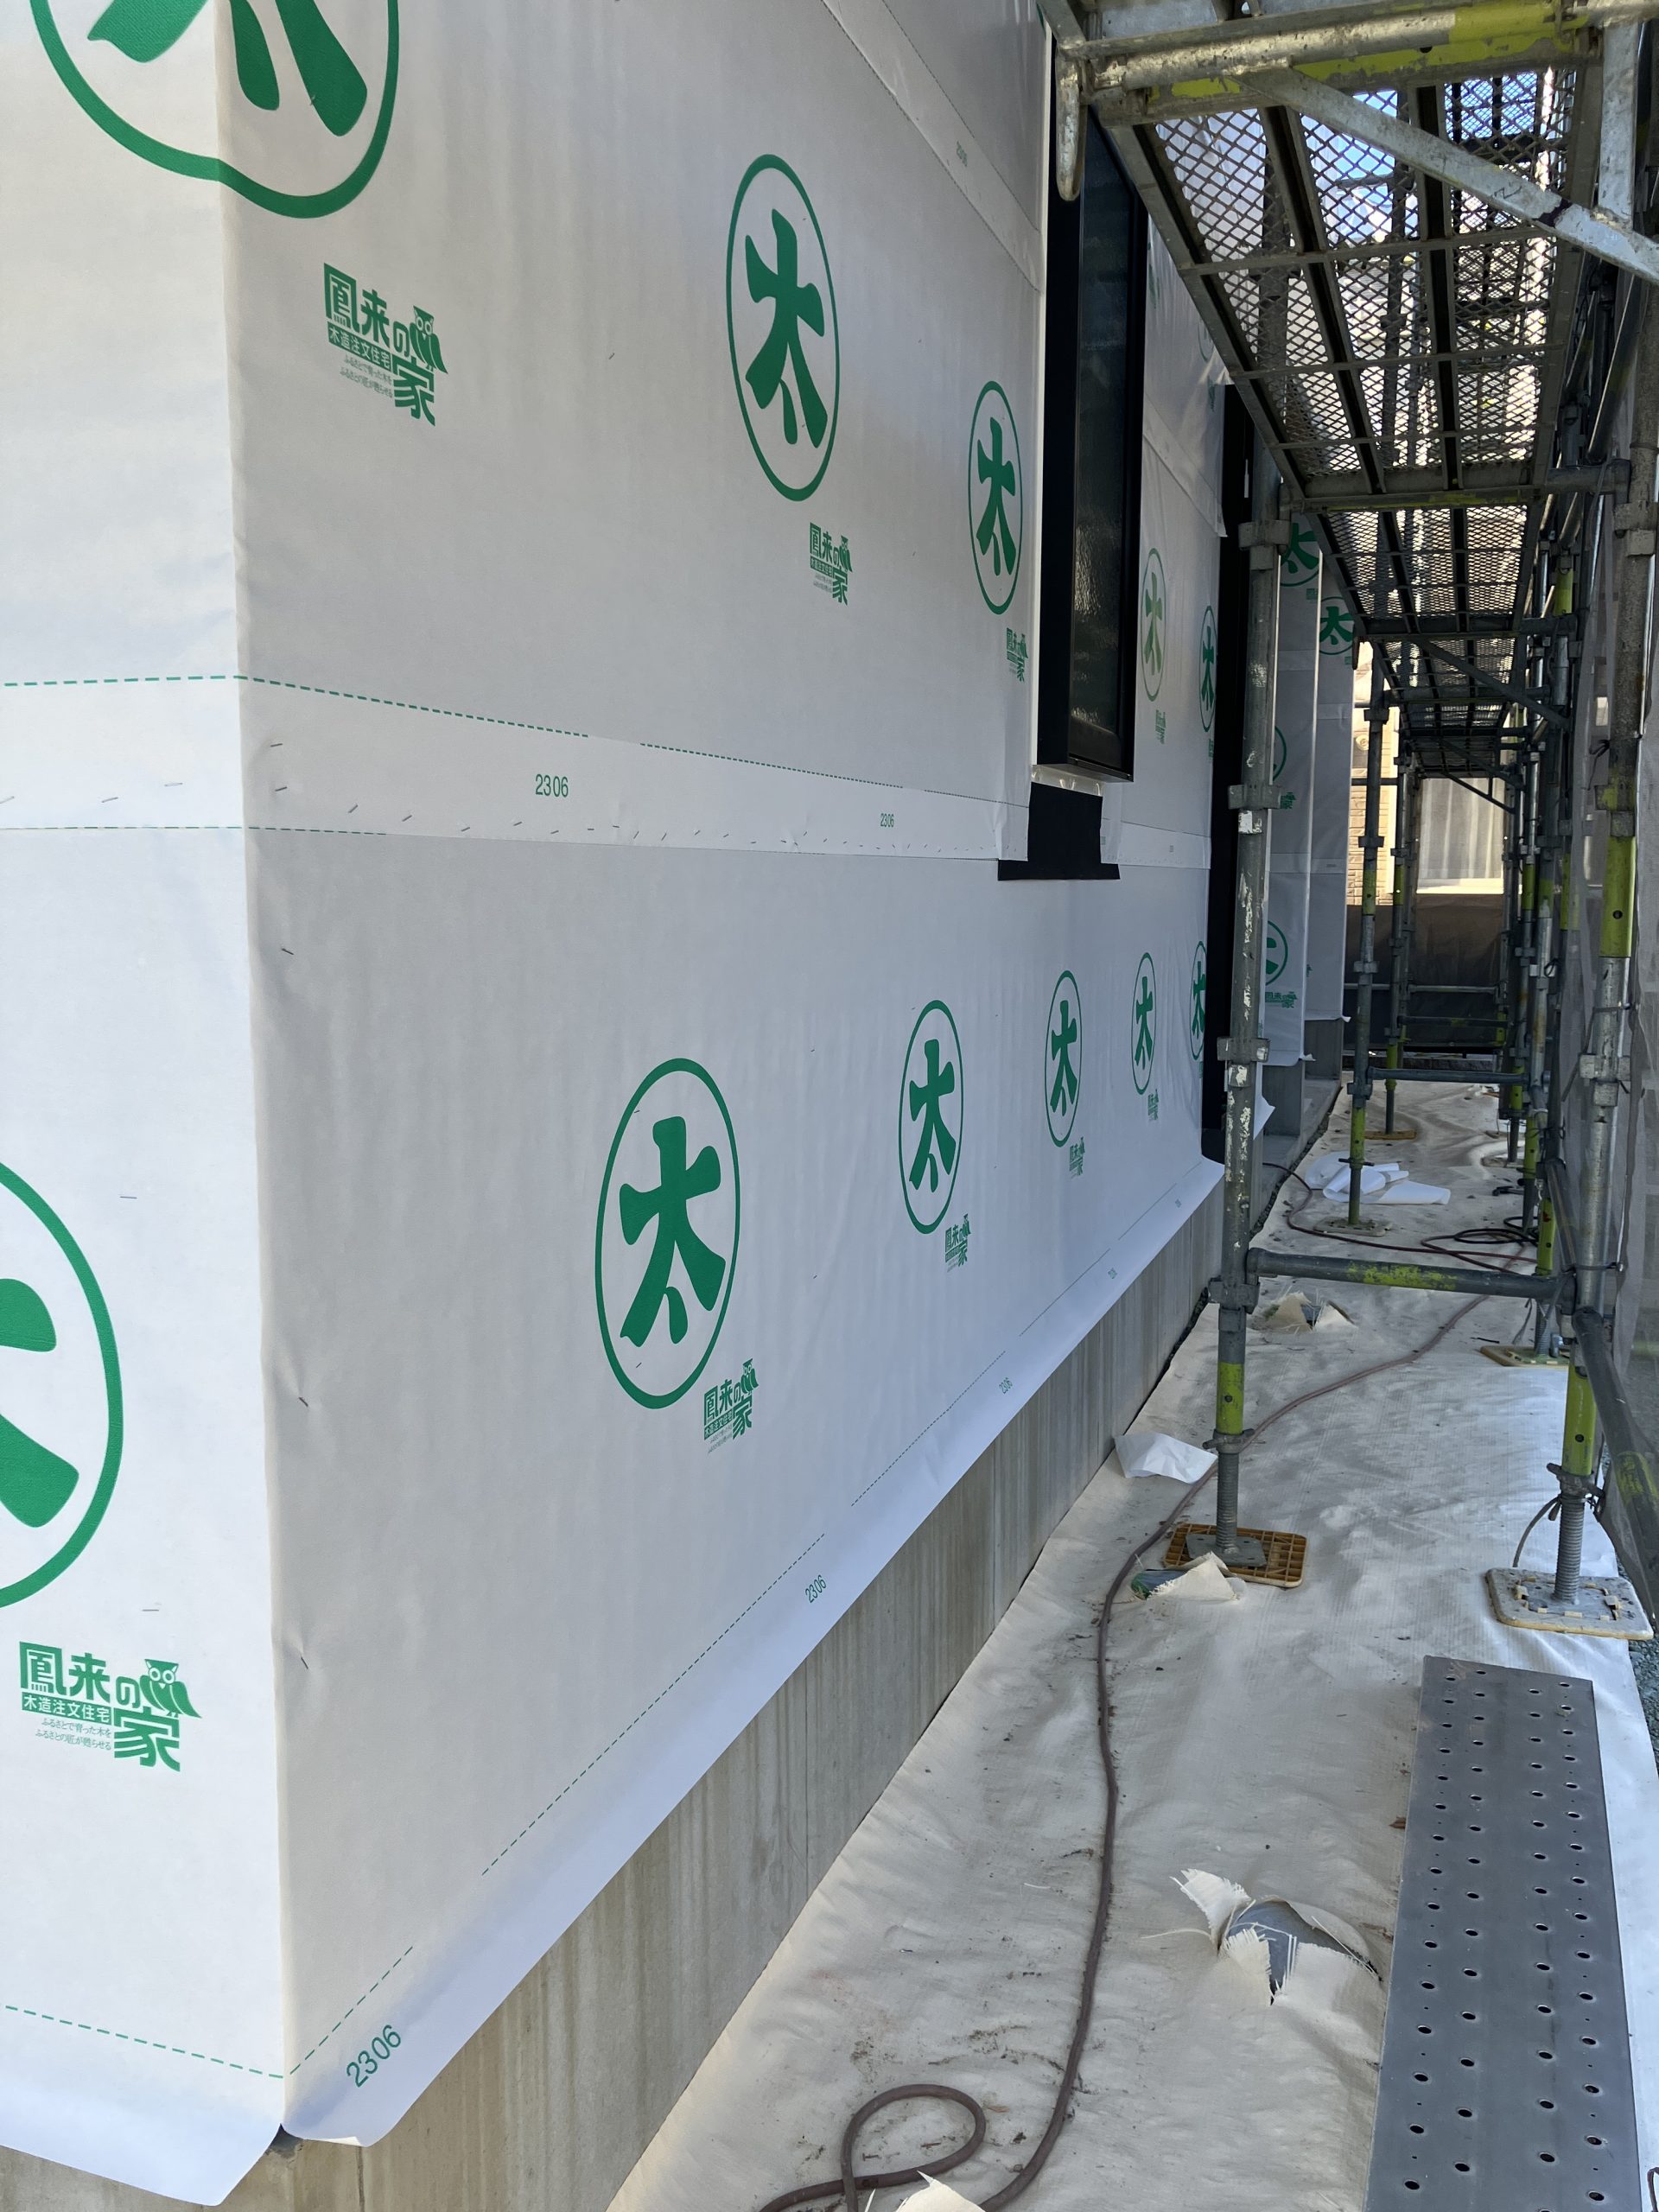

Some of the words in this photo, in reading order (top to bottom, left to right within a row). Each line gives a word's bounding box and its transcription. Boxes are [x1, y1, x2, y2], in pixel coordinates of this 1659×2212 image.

[328, 324, 391, 369] 木造注文住宅
[536, 773, 569, 798] 2306
[805, 1574, 827, 1604] 2306
[23, 1694, 111, 1724] 木造注文住宅
[346, 2024, 401, 2088] 2306
